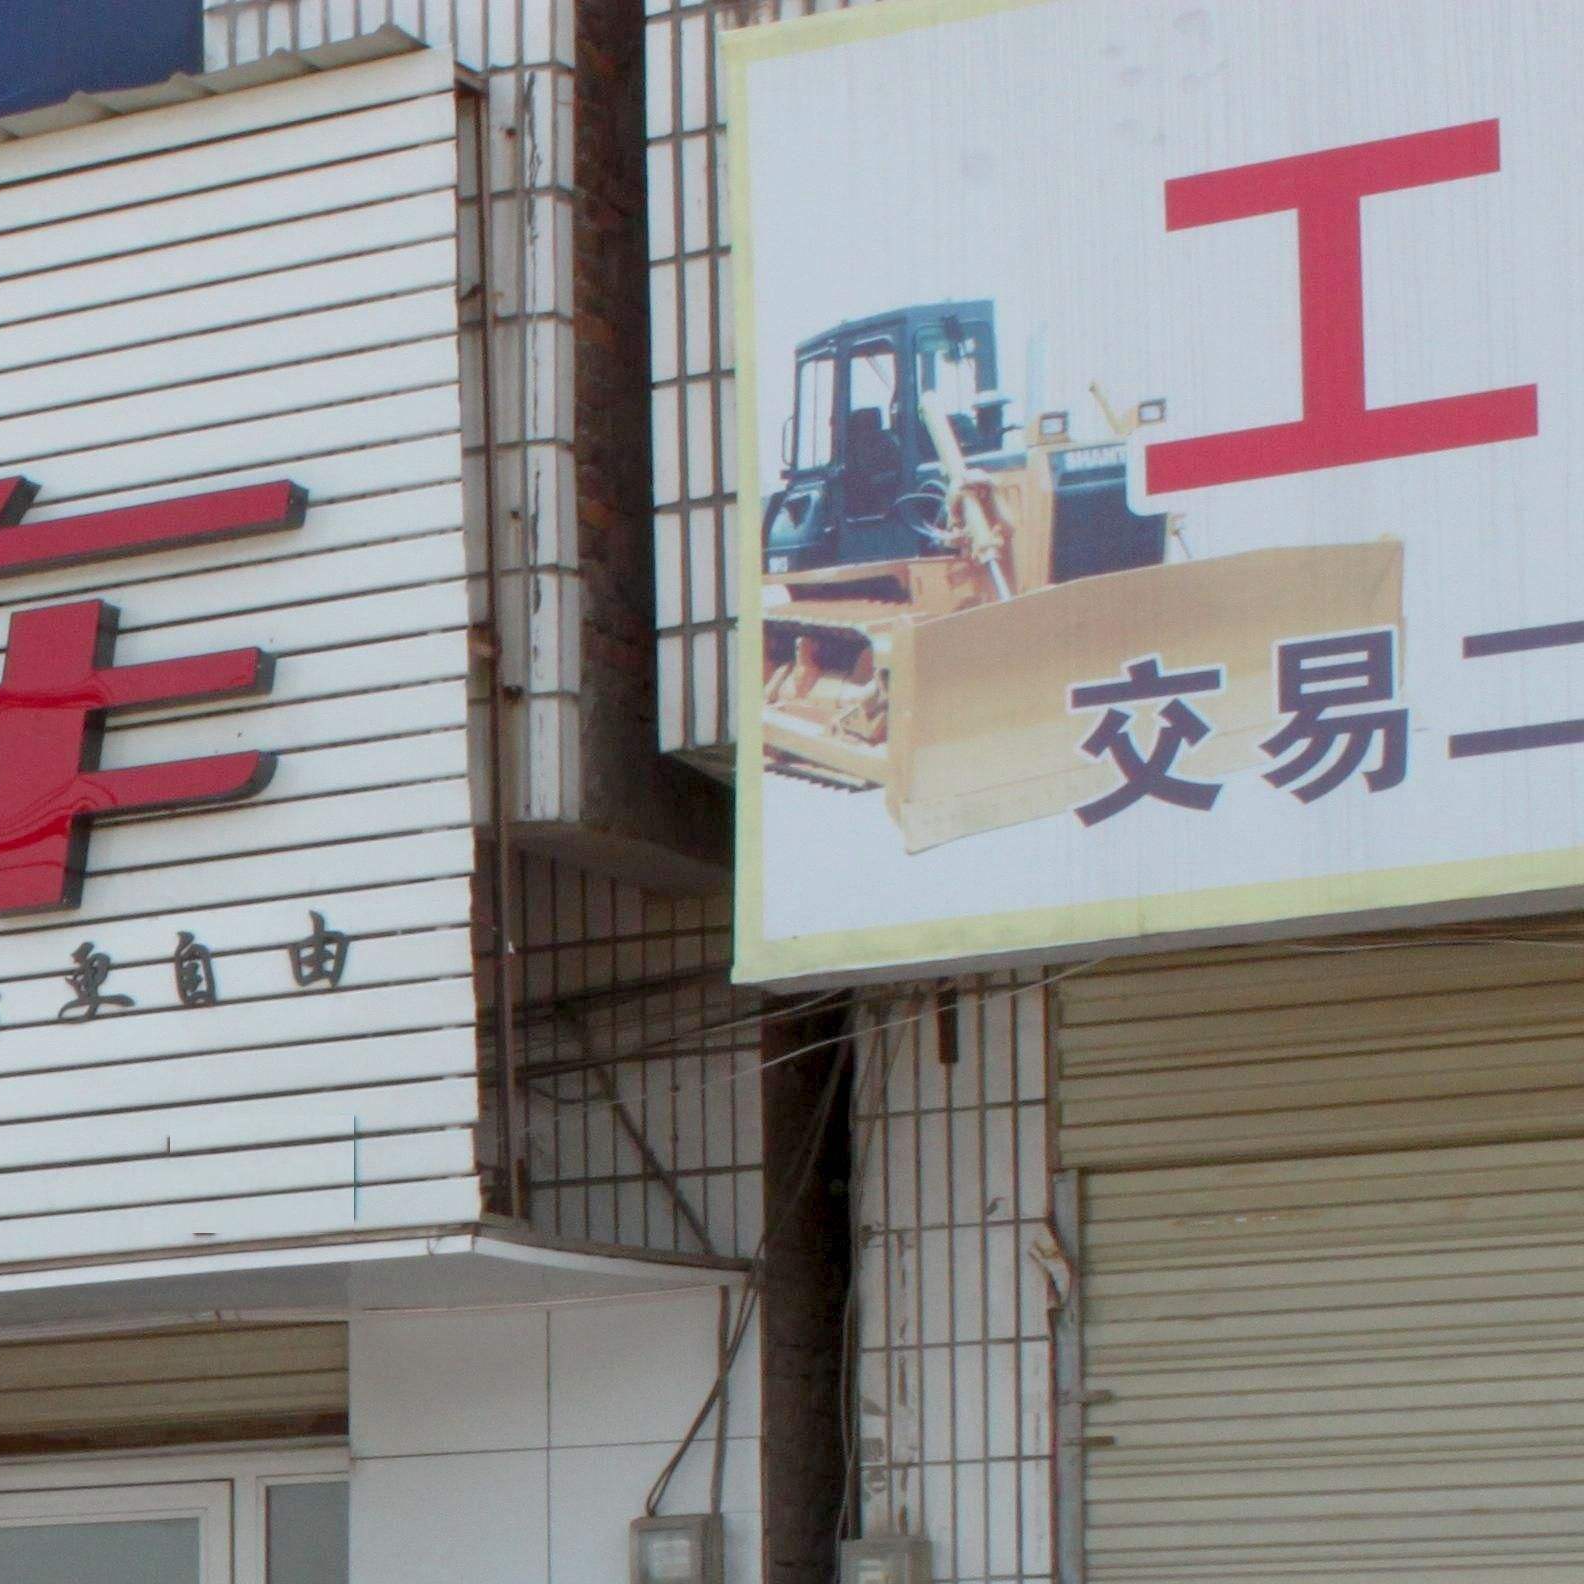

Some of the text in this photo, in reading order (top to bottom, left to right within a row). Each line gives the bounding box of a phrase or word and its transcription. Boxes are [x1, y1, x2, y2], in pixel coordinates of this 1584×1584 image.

[1146, 118, 1539, 496] 工
[1072, 622, 1584, 826] 交易二
